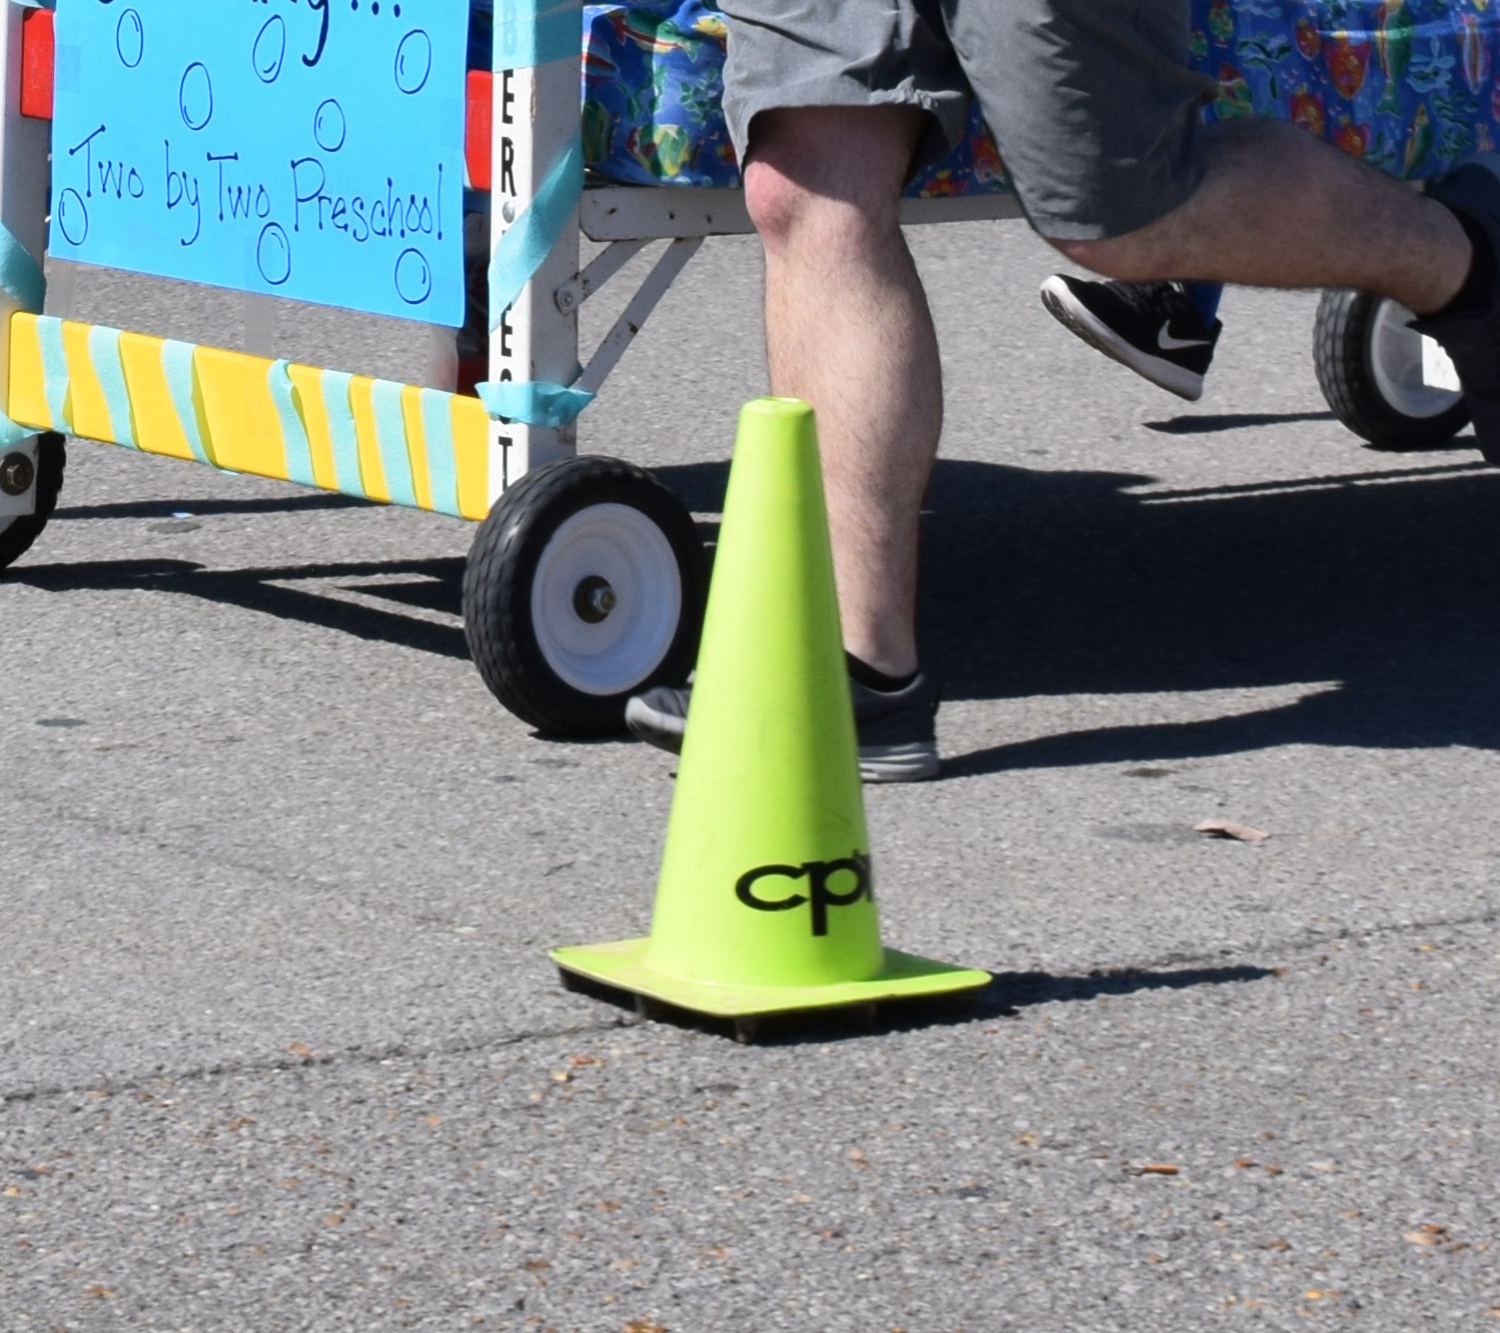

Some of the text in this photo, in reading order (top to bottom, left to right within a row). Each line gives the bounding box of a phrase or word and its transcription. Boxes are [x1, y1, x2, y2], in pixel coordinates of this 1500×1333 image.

[69, 124, 444, 246] Two by Two Preschool
[735, 849, 872, 937] cp
